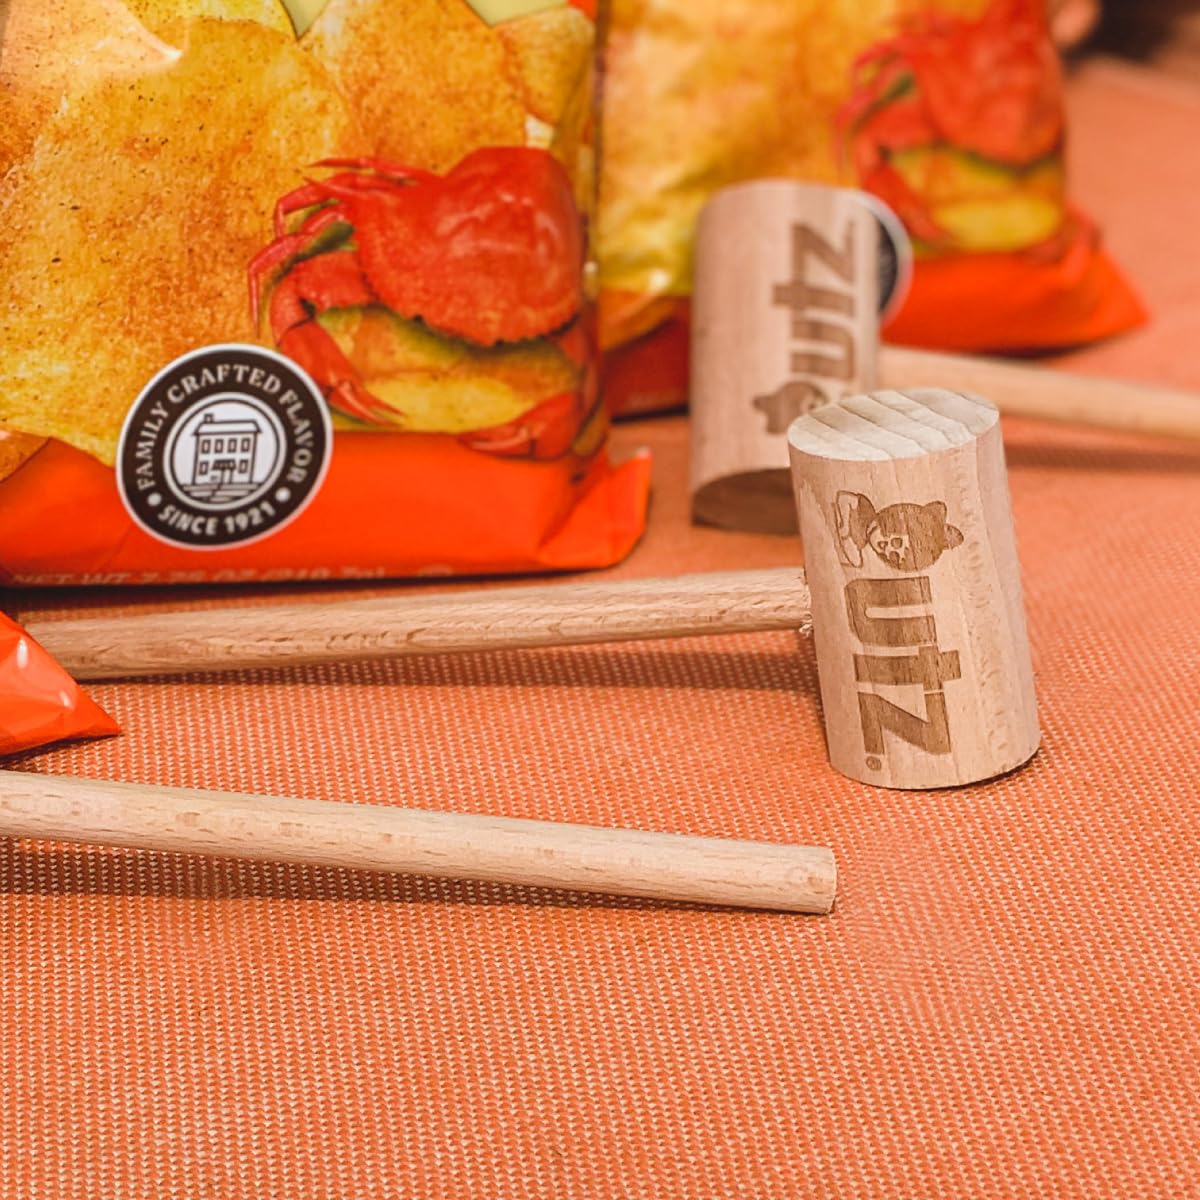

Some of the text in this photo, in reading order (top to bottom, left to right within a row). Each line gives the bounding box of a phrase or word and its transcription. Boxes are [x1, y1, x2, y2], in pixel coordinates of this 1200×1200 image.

[135, 364, 315, 491] FAMILY CRAFTED FLAVOR
[157, 503, 276, 536] SINCE 1921
